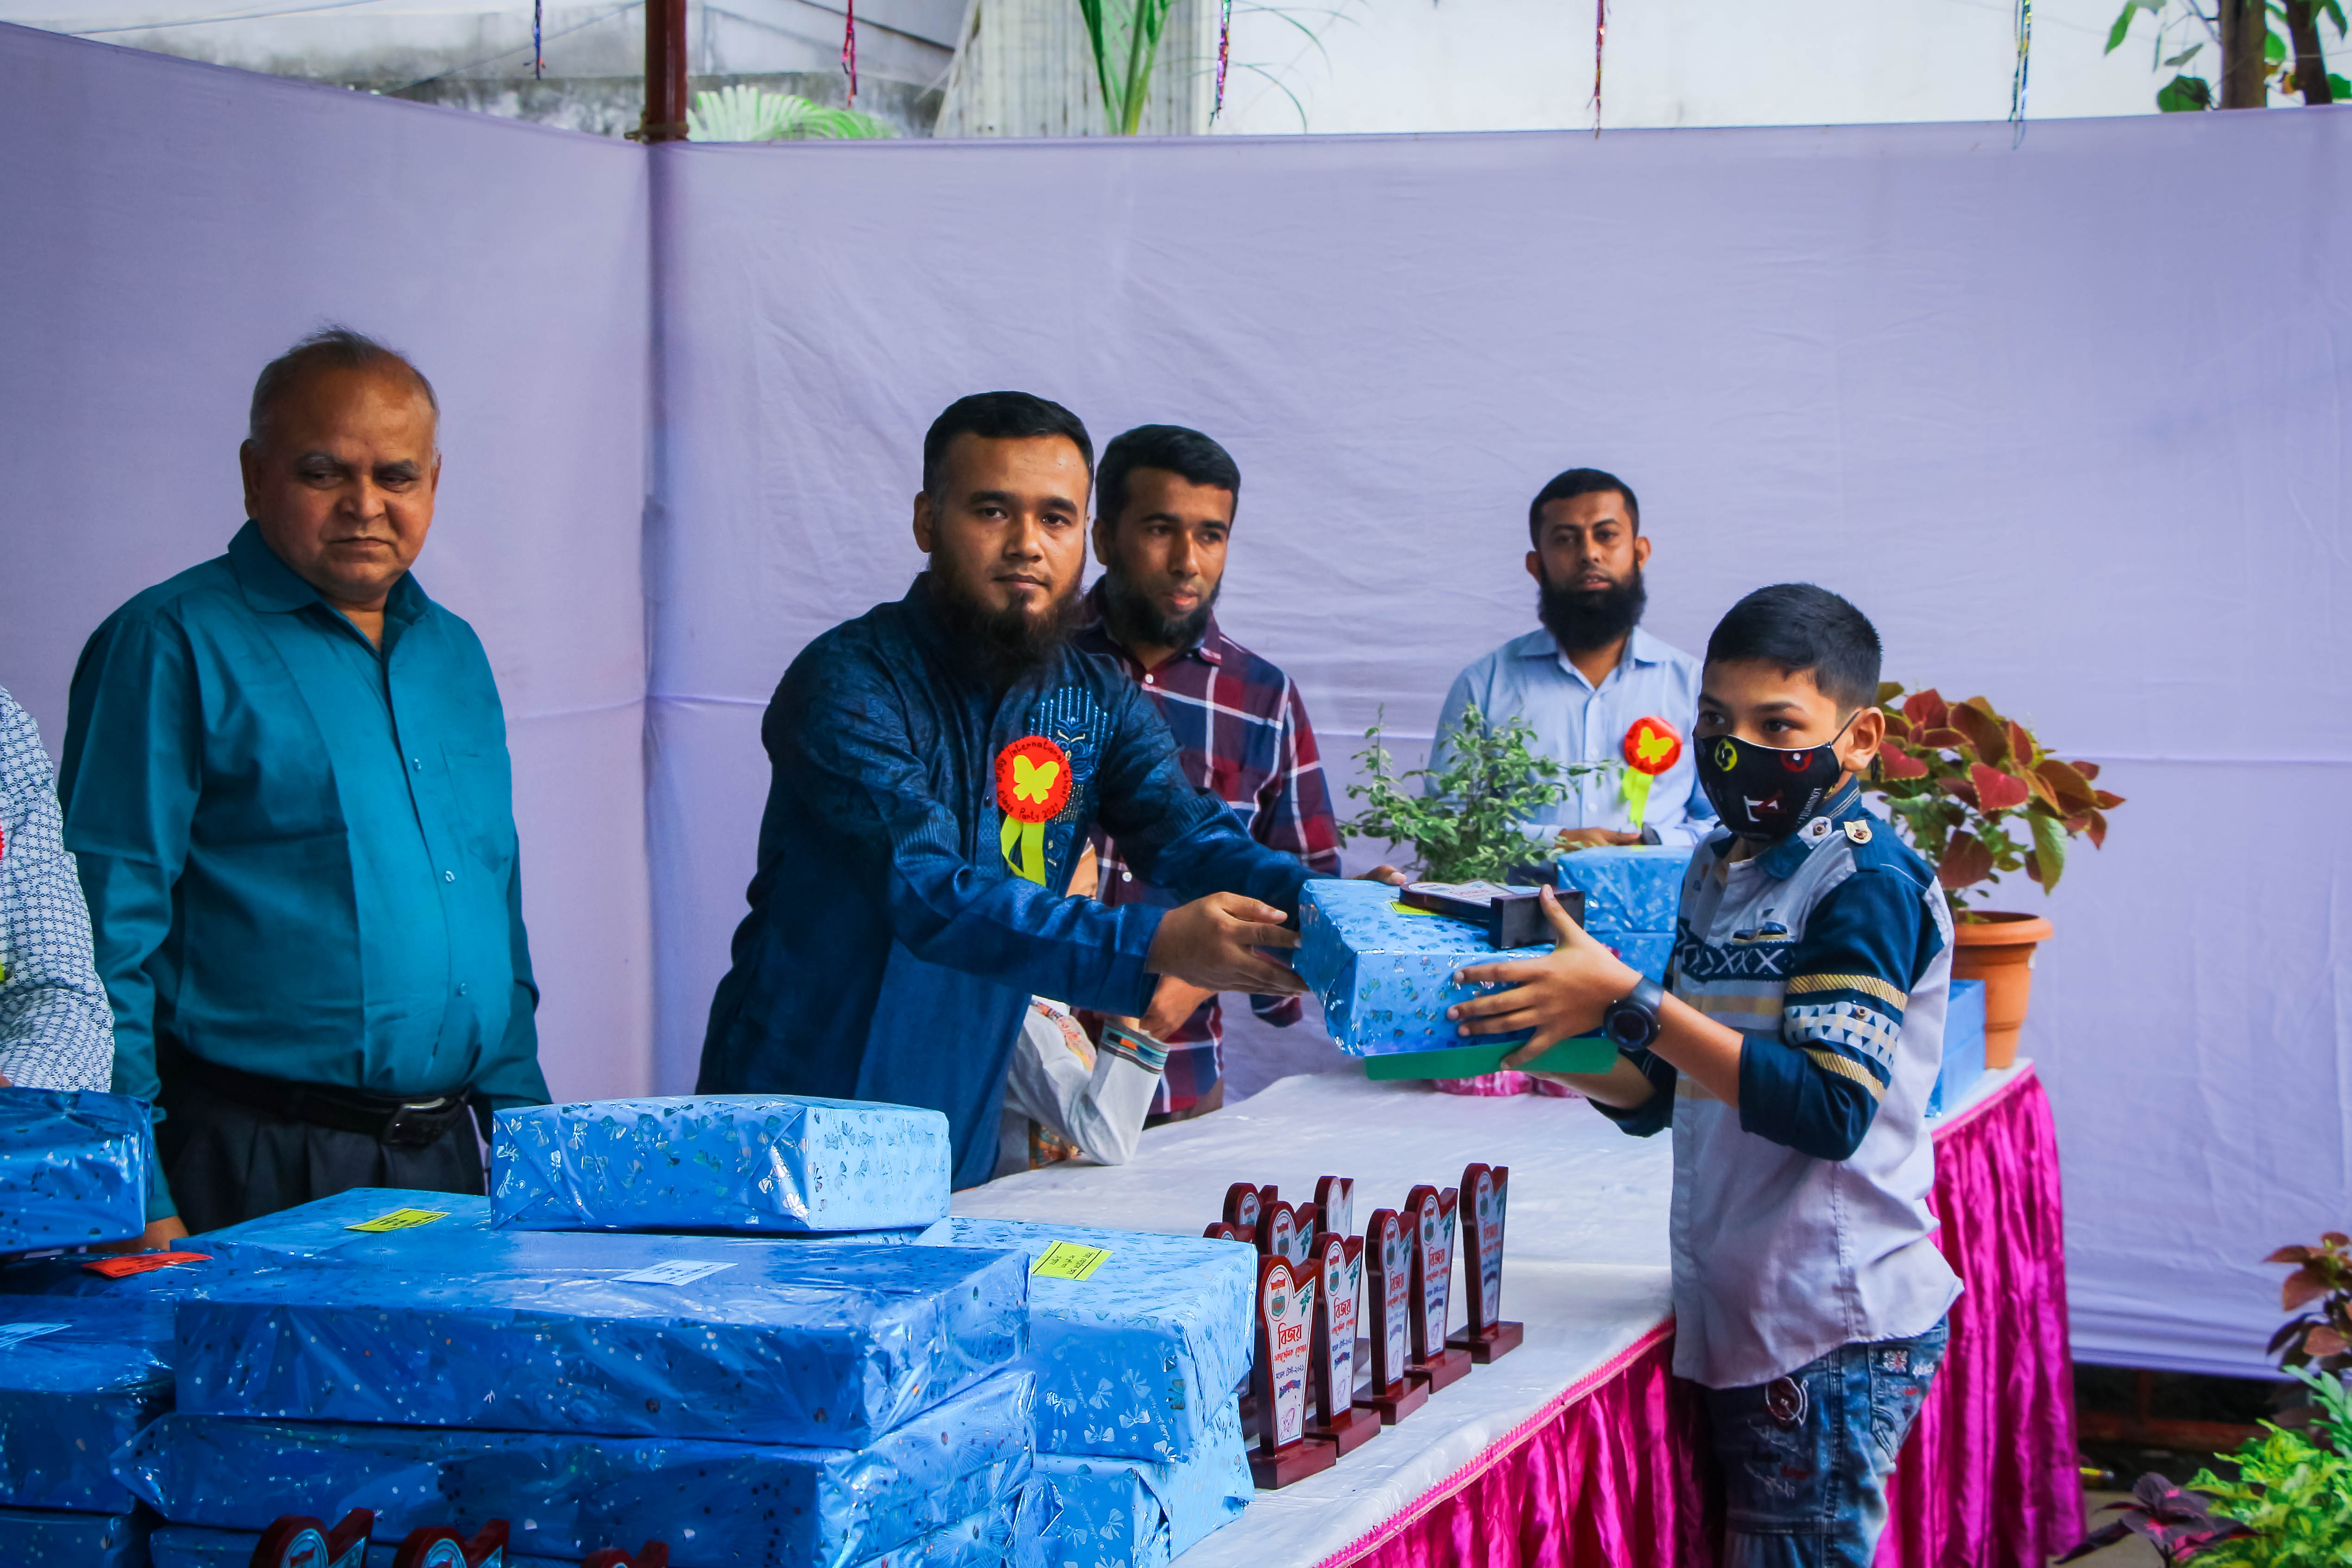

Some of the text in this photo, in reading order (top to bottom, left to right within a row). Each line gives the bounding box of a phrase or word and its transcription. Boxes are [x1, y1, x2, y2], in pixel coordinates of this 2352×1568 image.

[1008, 742, 1066, 764] International
[997, 790, 1059, 822] Class Party 2021
[1334, 1297, 1351, 1323] বিজয়
[1278, 1322, 1302, 1349] বিজয়
